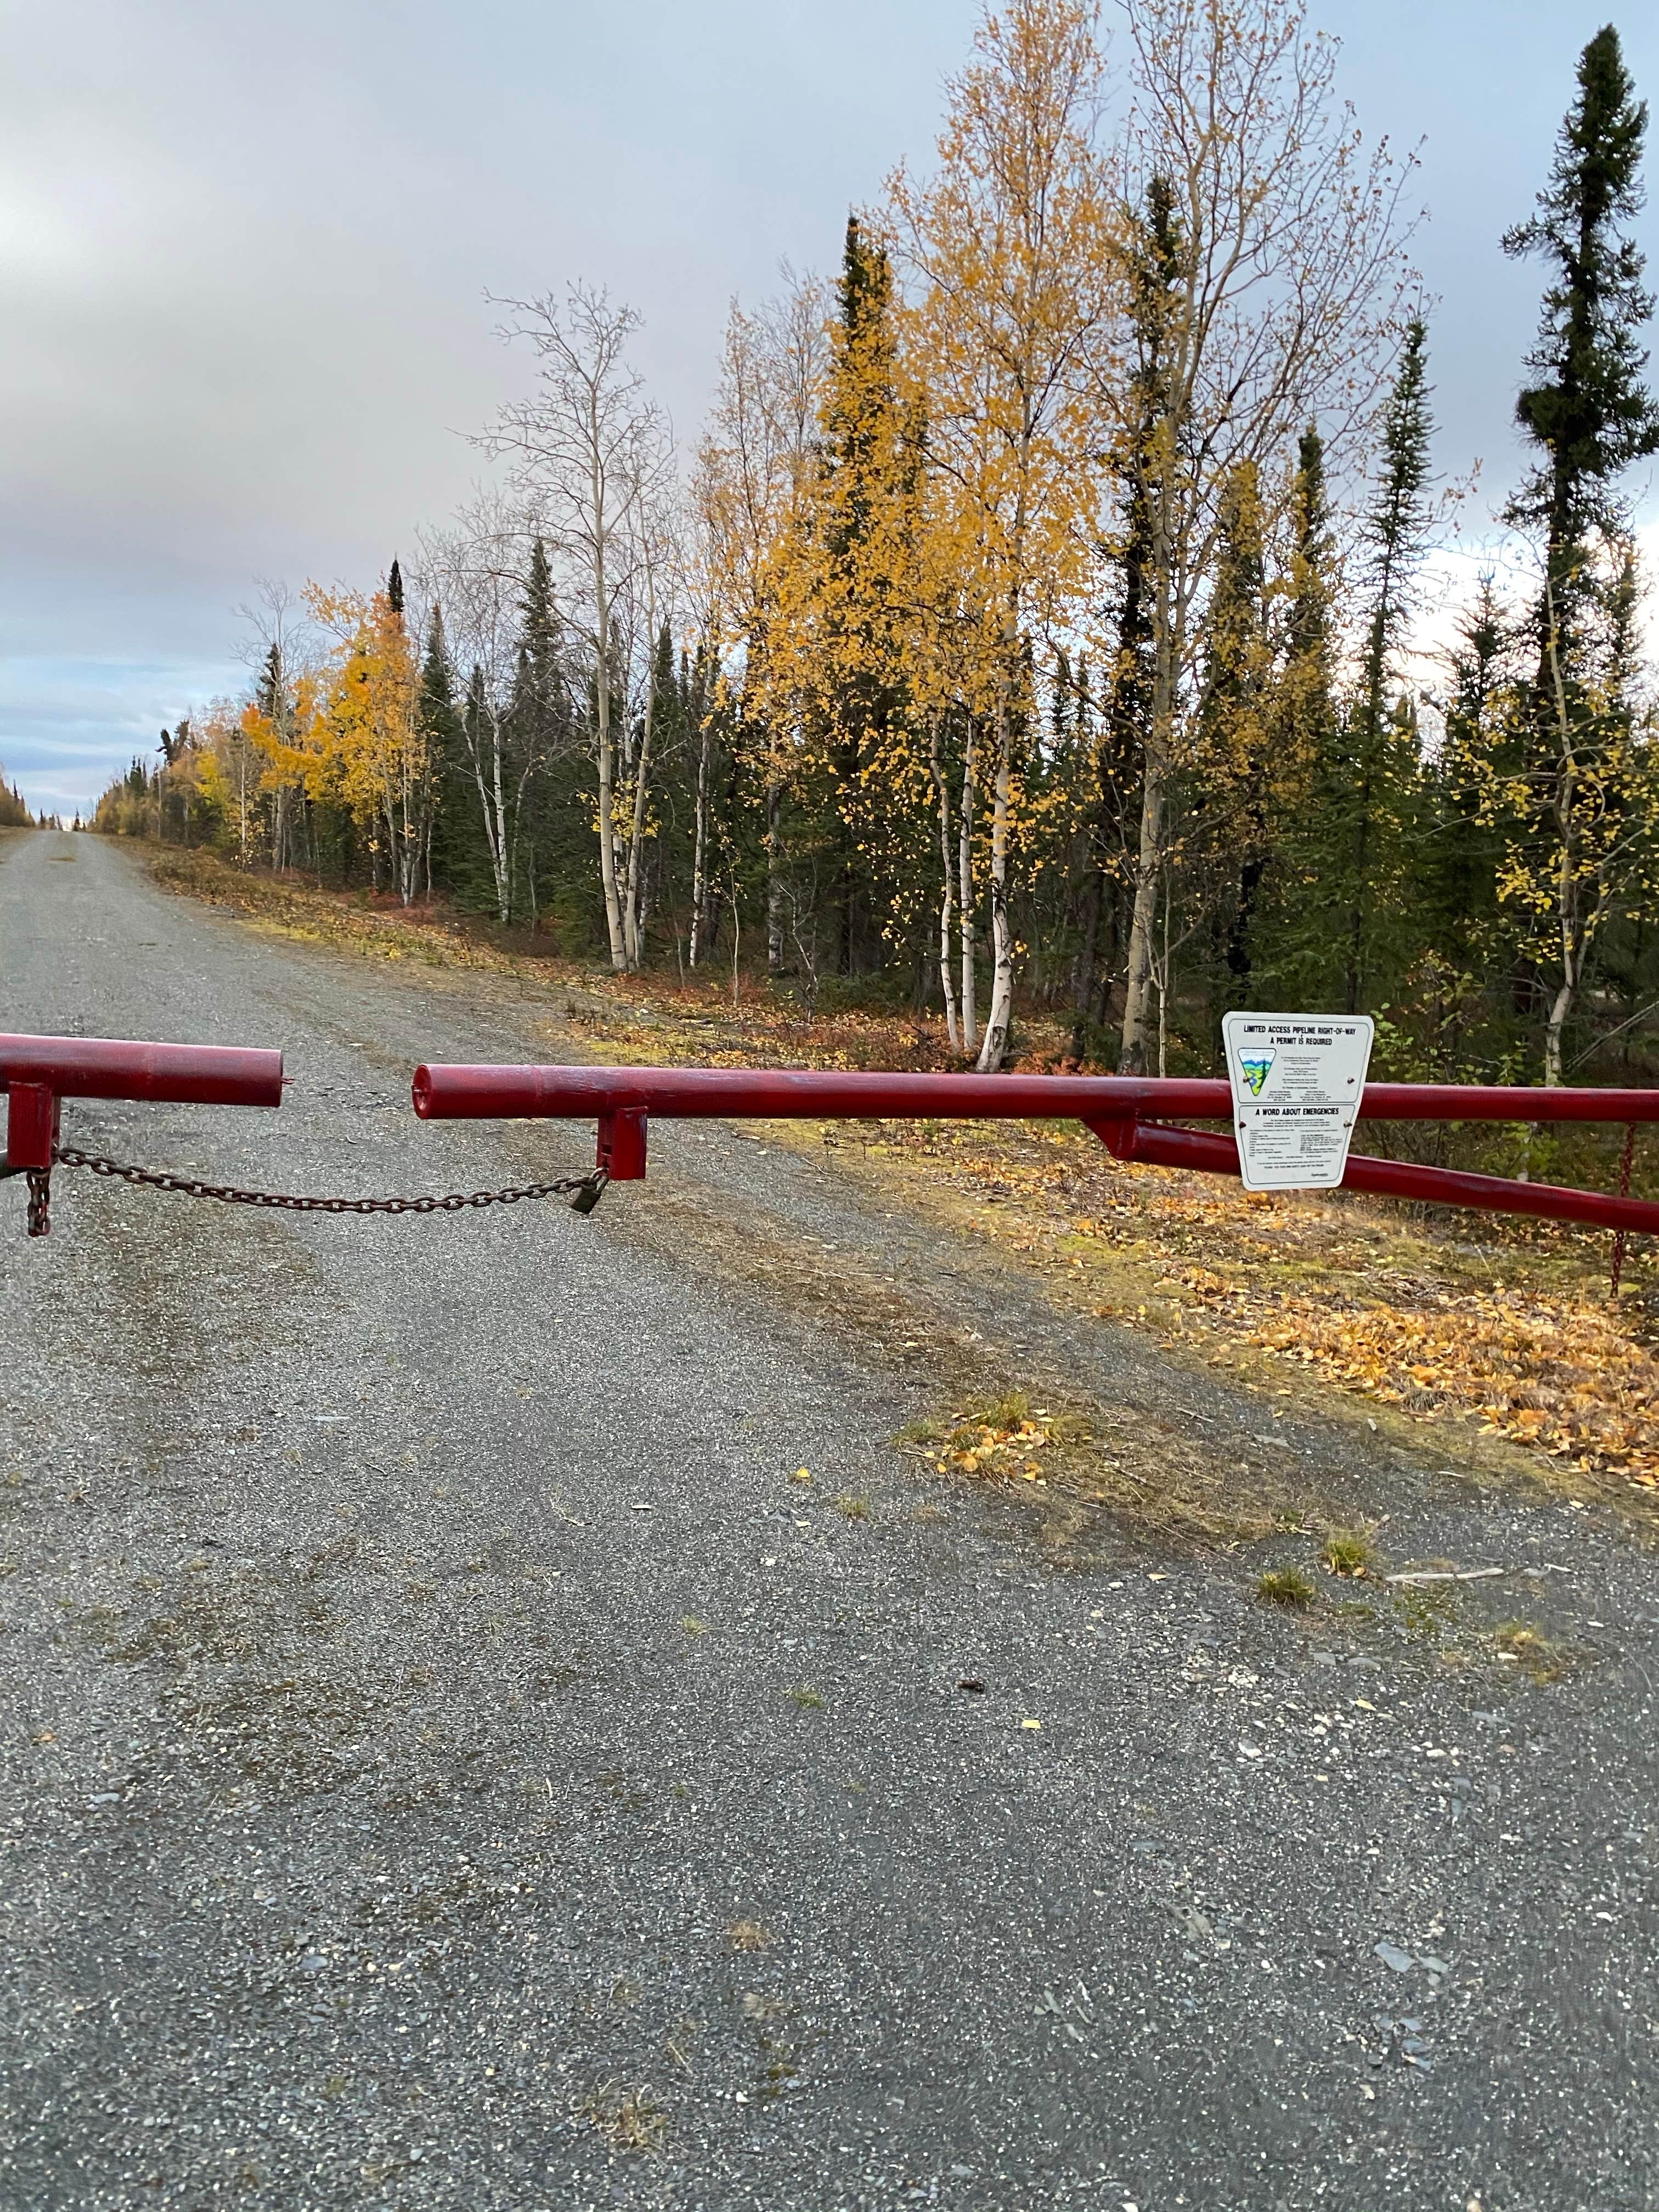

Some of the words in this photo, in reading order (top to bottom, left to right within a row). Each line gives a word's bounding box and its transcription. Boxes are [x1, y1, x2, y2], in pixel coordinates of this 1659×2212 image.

[1244, 1025, 1266, 1033] LIMITED
[1268, 1025, 1291, 1034] ACCESS
[1318, 1027, 1356, 1035] RIGHT-OF-WAY
[1306, 1037, 1333, 1046] REQUIRED
[1302, 1107, 1339, 1115] EMERGENCIES
